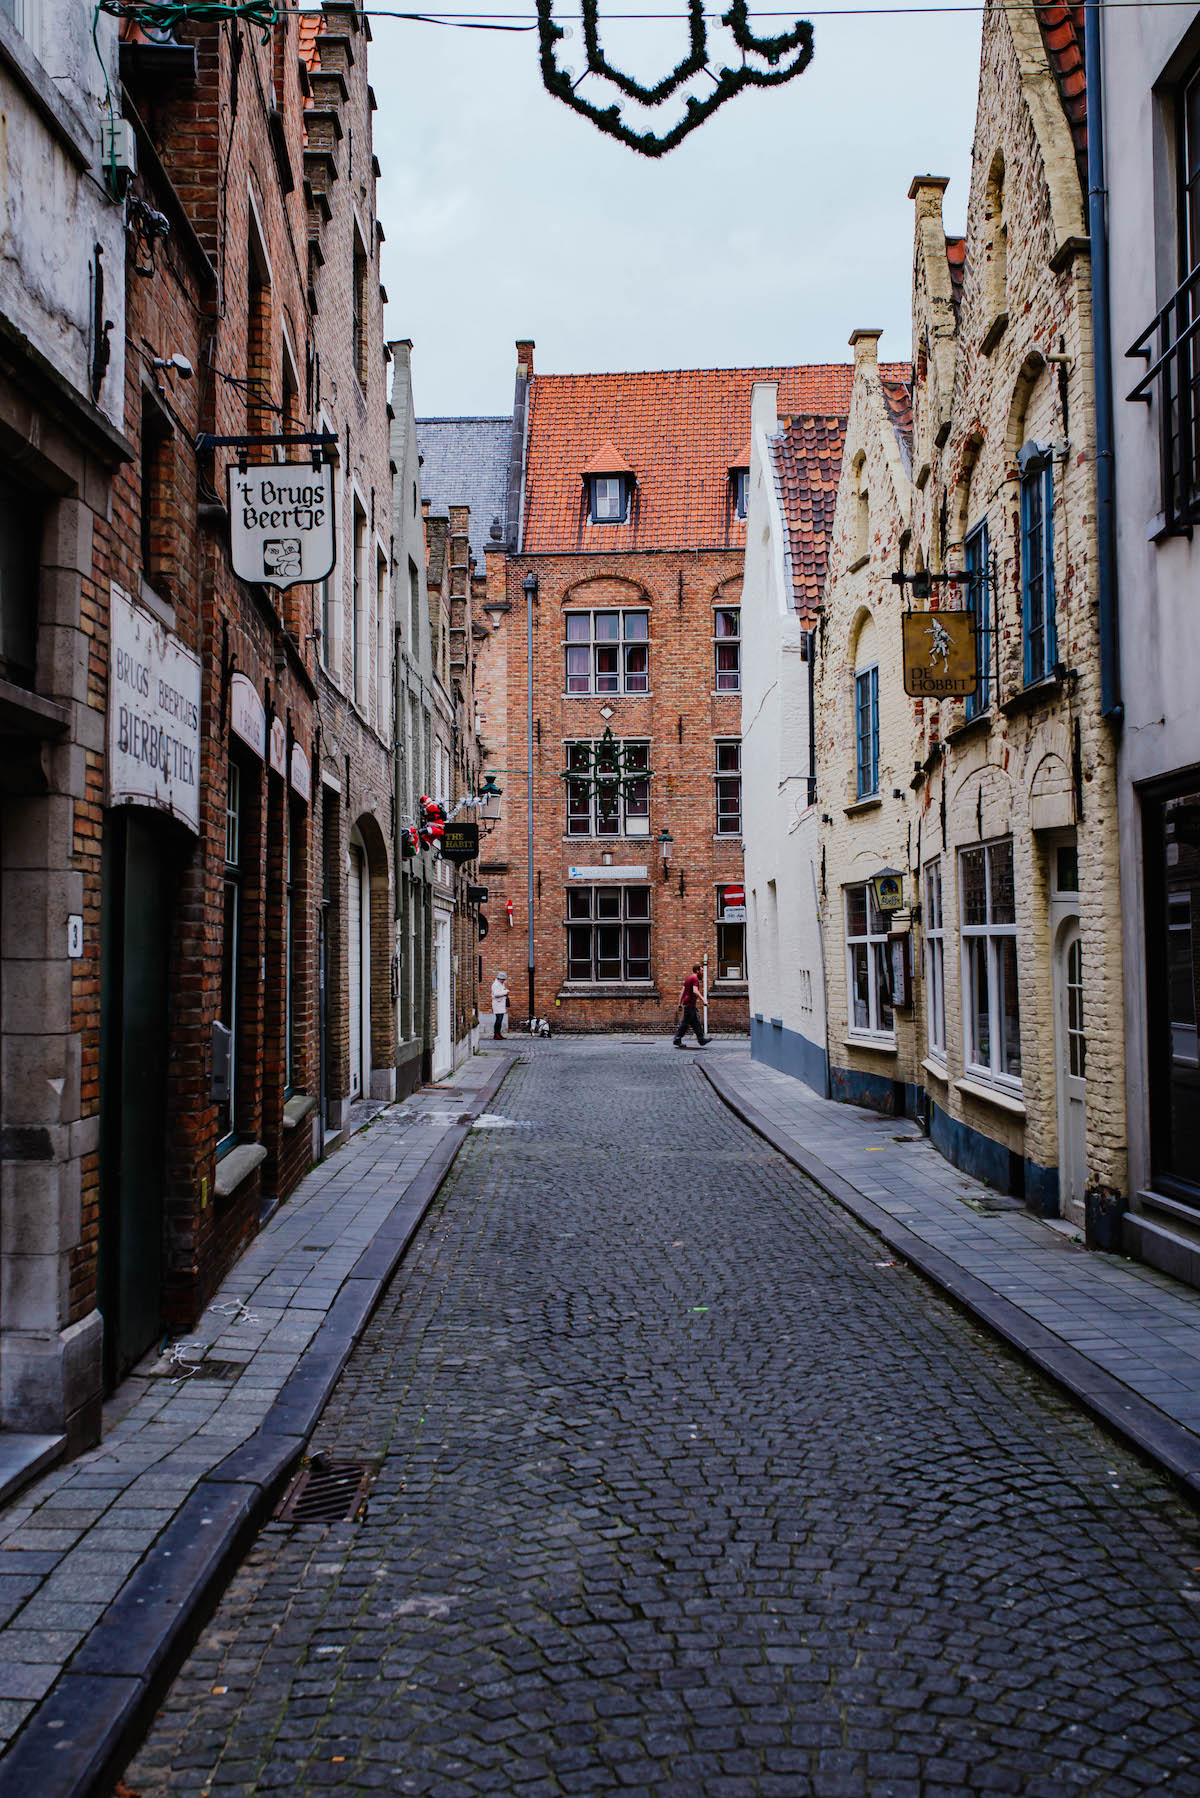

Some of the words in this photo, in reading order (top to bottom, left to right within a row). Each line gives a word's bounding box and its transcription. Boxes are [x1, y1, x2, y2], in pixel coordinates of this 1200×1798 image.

[236, 482, 254, 506] 't
[260, 480, 325, 508] Brugs
[242, 506, 325, 531] Beertje
[116, 648, 149, 698] BRUGS
[911, 667, 932, 679] DE
[911, 679, 968, 691] HOBBIT
[158, 679, 198, 731] BEERTJES
[118, 706, 196, 786] BIERBOETIEK
